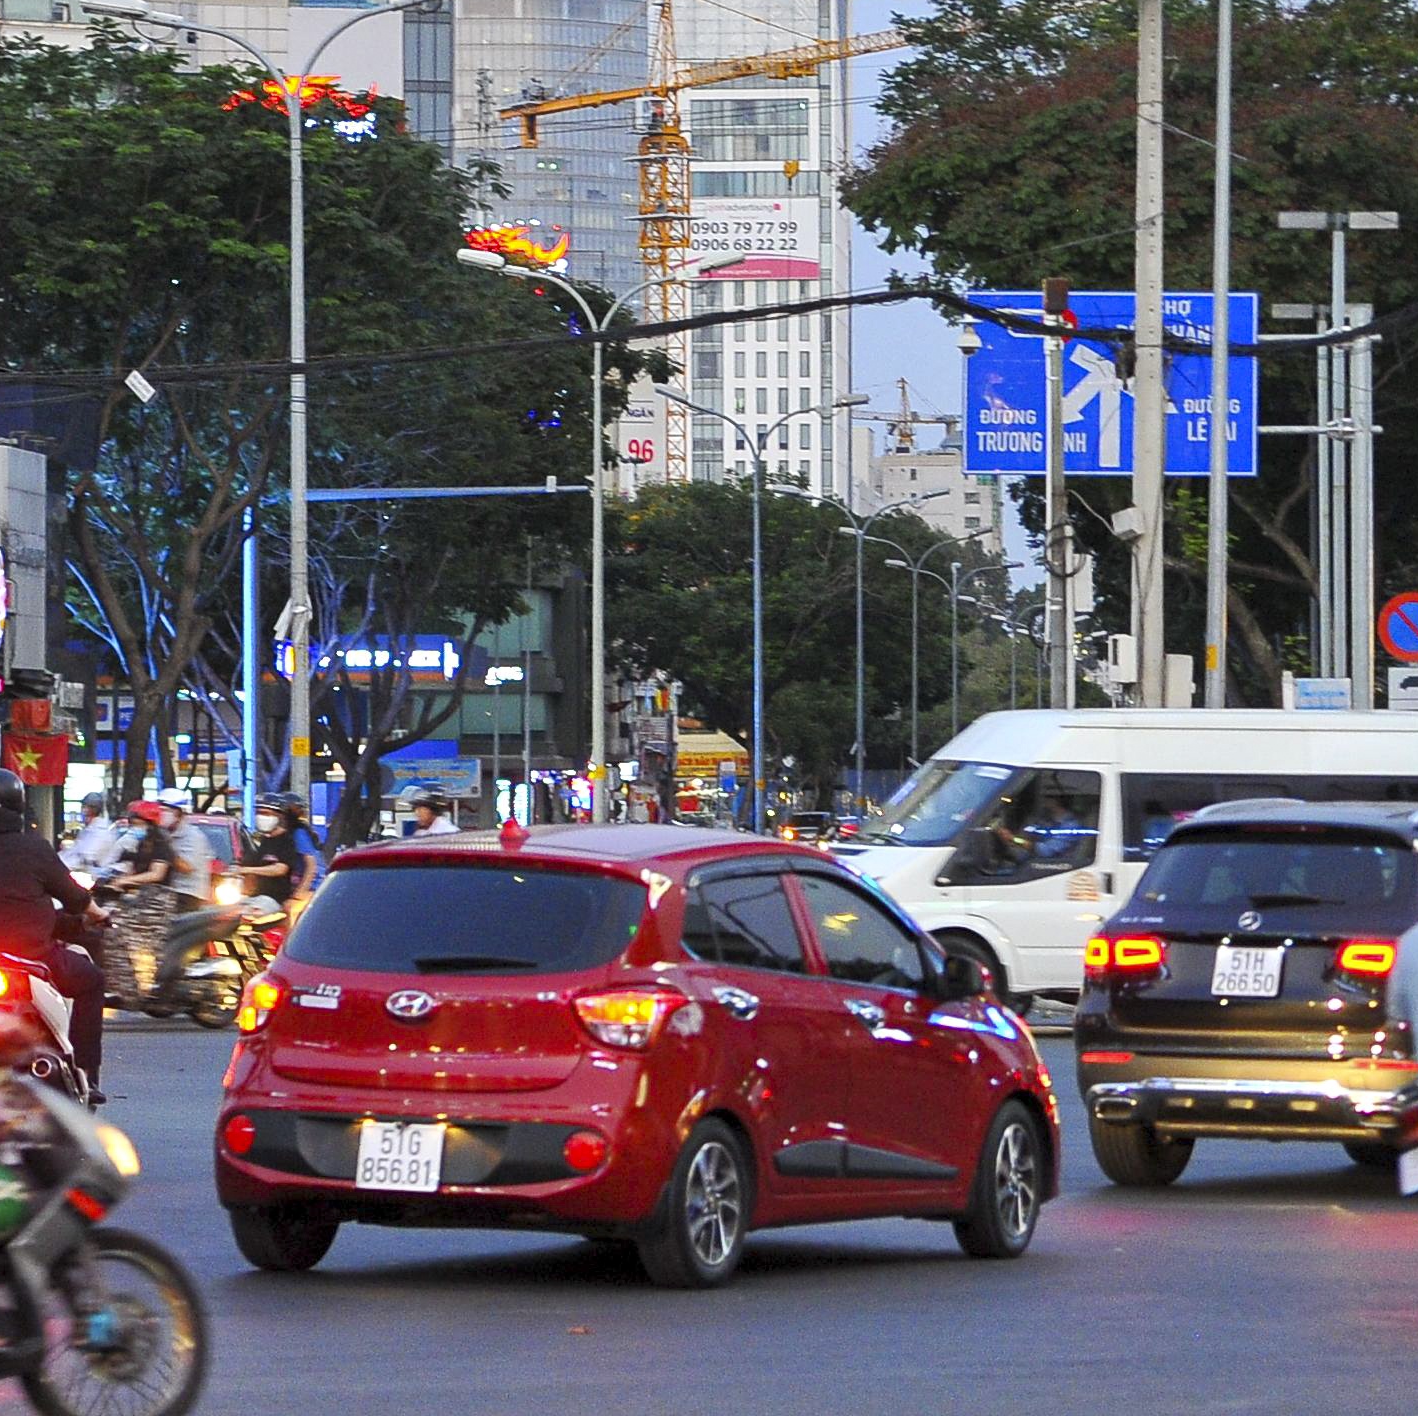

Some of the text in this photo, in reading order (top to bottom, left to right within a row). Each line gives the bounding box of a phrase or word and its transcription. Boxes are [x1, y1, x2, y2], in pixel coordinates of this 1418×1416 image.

[691, 222, 798, 234] 0903 79 77 99
[691, 239, 798, 251] 0906 68 22 22
[1187, 417, 1208, 442] LÊ
[628, 439, 654, 463] 96
[1230, 951, 1266, 970] 51H
[381, 1129, 422, 1156] 51G
[361, 1157, 432, 1186] 856.81
